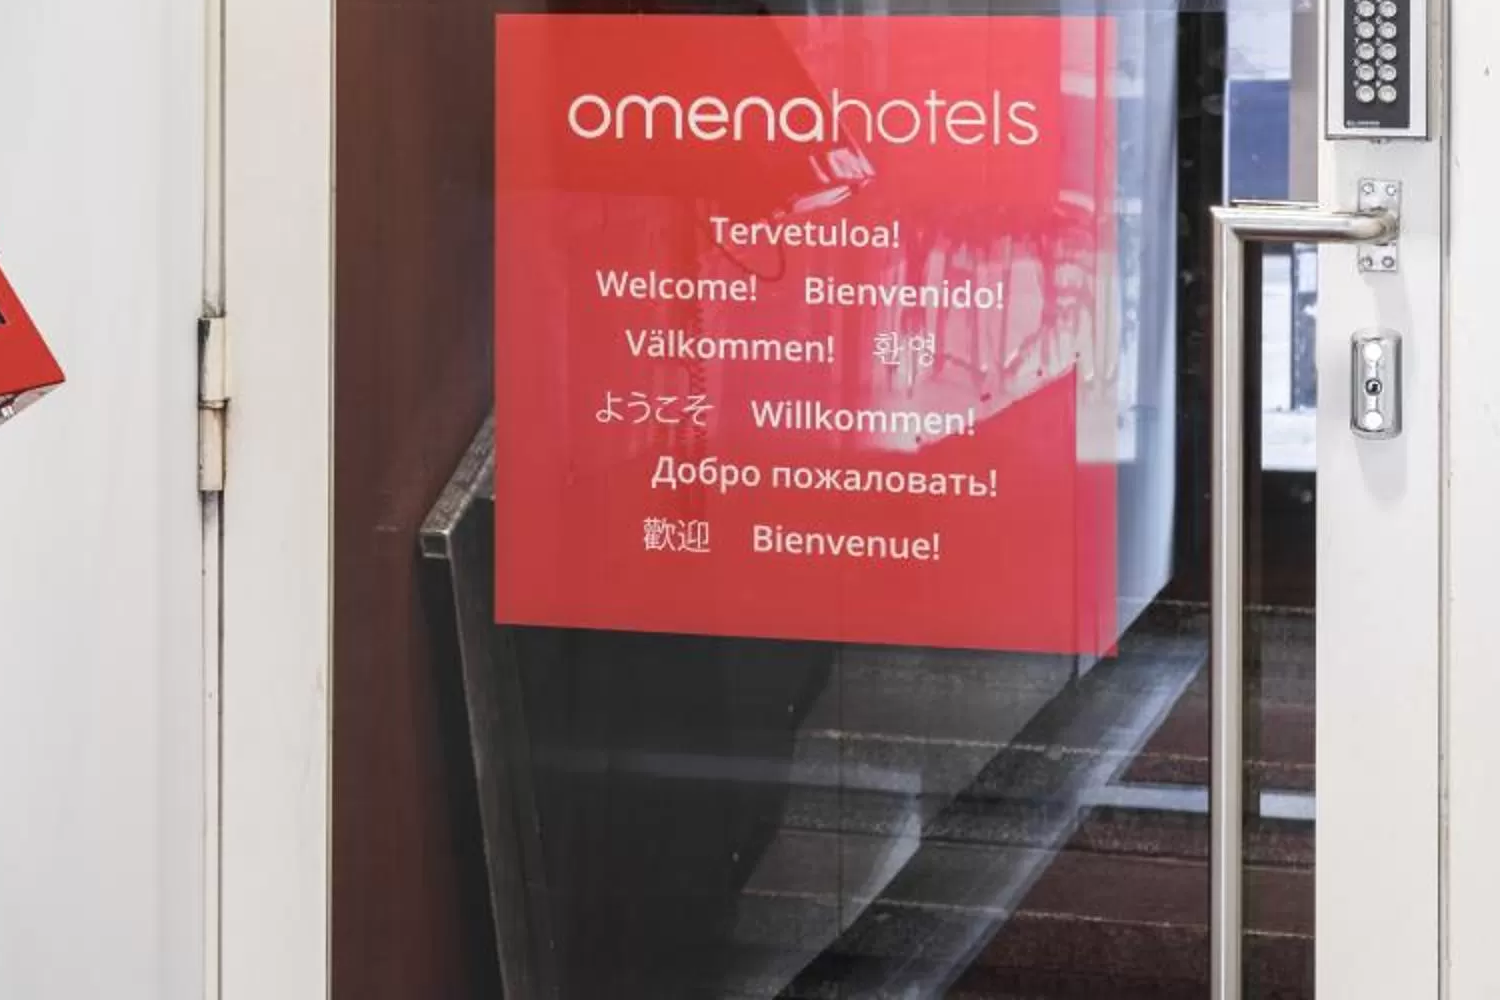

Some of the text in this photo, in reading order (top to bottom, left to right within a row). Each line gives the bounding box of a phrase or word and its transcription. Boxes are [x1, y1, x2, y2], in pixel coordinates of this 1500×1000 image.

[709, 216, 900, 249] Tervetuloa!
[595, 270, 1004, 310] Welcome! Bienvenido!
[625, 329, 835, 364] Välkommen!
[872, 331, 935, 367] 환영
[595, 391, 715, 427] ようこそ
[751, 399, 976, 437] Willkommen!
[651, 455, 998, 498] Добро пожаловать!
[643, 516, 711, 553] 歡迎
[753, 524, 941, 561] Bienvenue!
